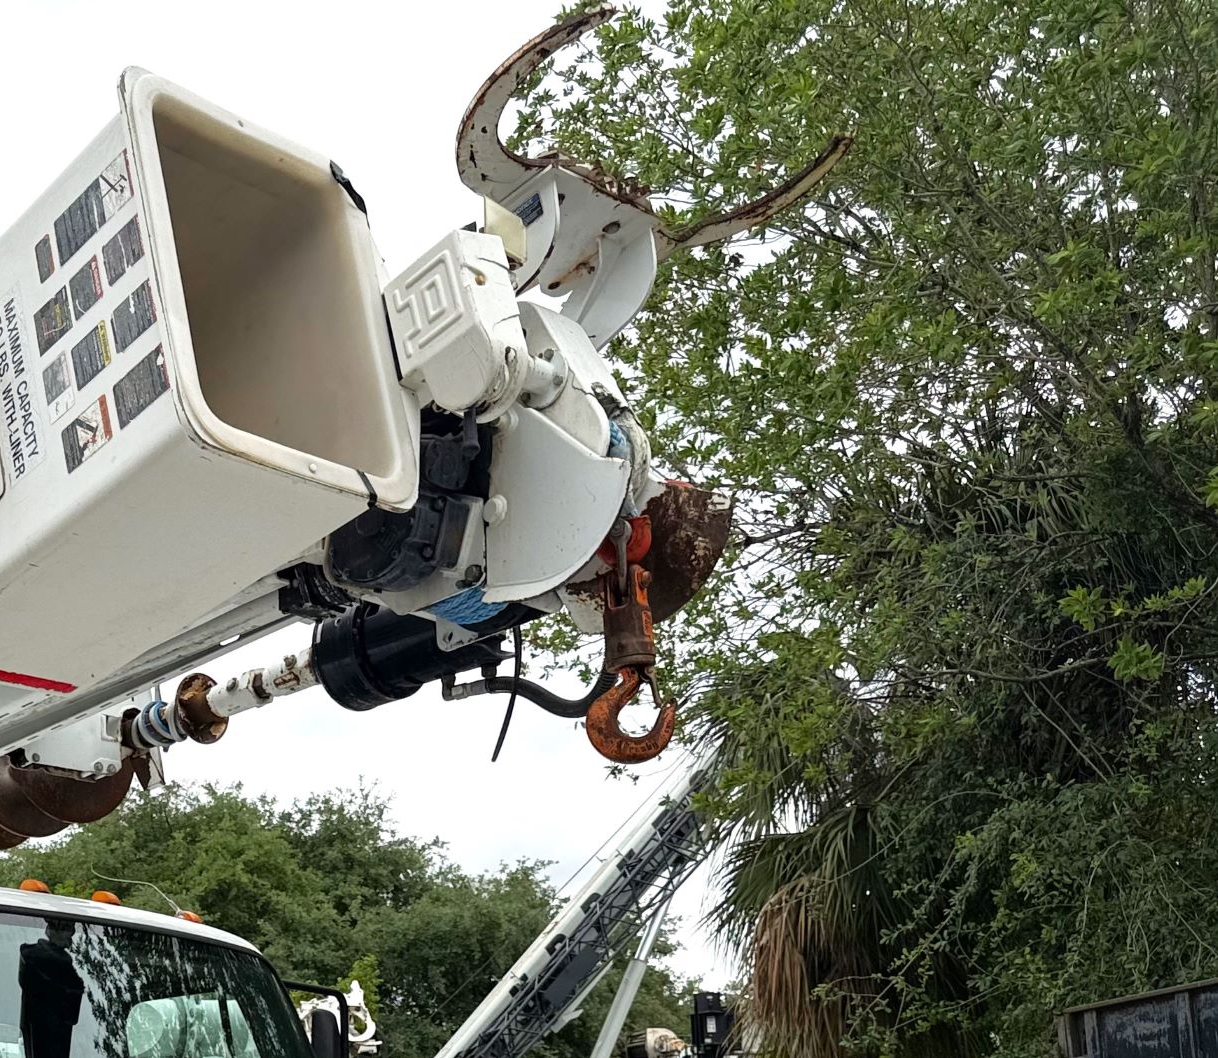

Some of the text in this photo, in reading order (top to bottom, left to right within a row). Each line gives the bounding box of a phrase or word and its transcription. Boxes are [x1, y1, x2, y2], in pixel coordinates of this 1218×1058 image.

[2, 383, 18, 421] WITH
[4, 298, 39, 458] MAXIMUM CAPACITY
[9, 428, 26, 479] LINER
